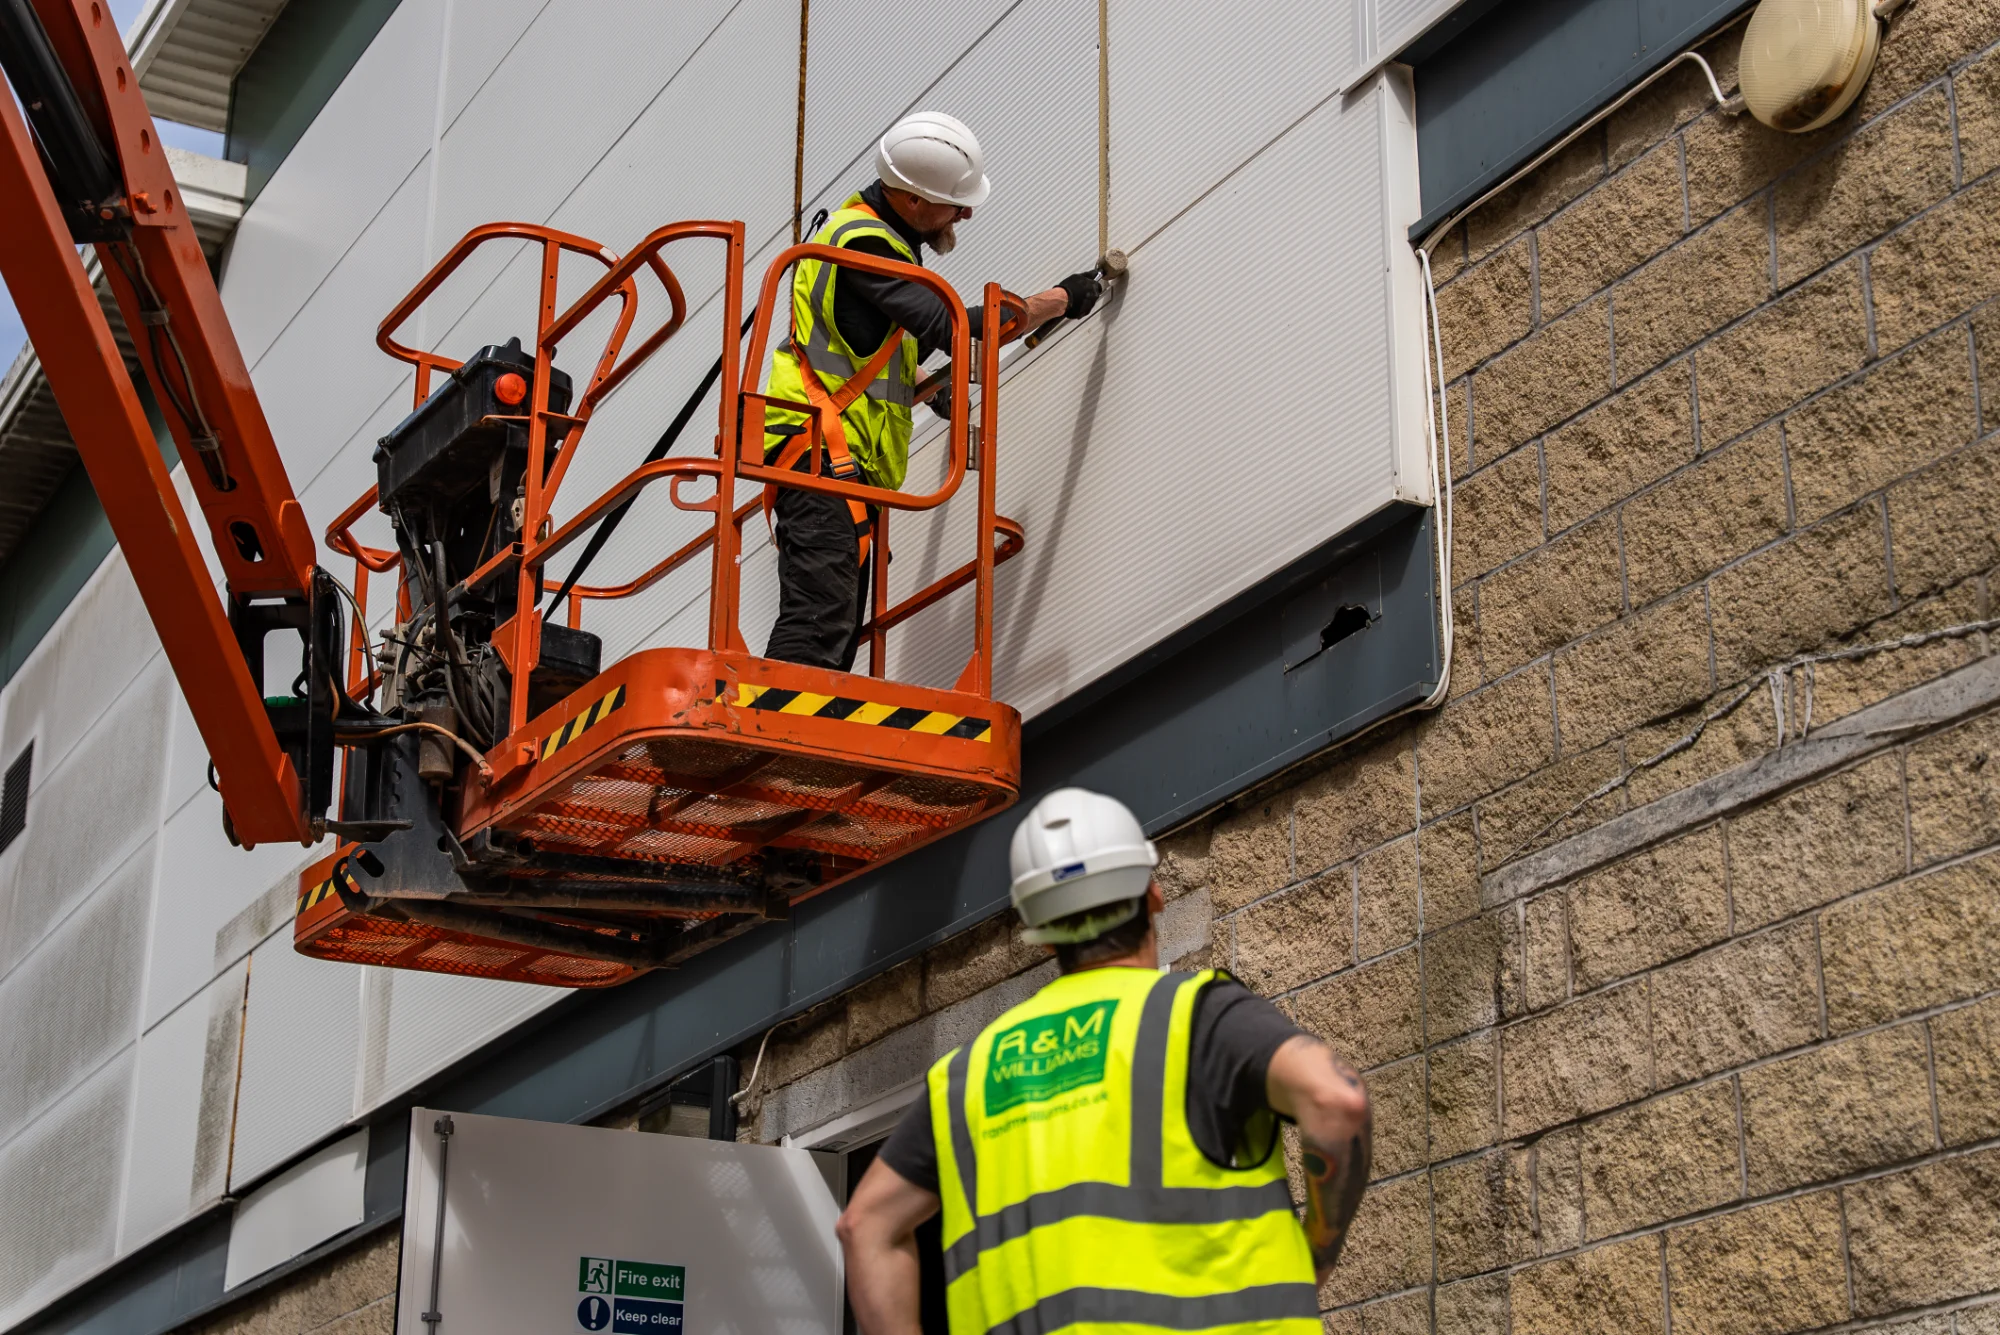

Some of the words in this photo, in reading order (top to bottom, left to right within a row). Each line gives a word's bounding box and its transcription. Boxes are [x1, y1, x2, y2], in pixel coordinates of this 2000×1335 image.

[992, 1039, 1099, 1083] WILLIAMS
[618, 1269, 648, 1286] Fire
[652, 1274, 681, 1289] exit
[616, 1308, 648, 1326] Keep
[651, 1314, 682, 1326] clear
